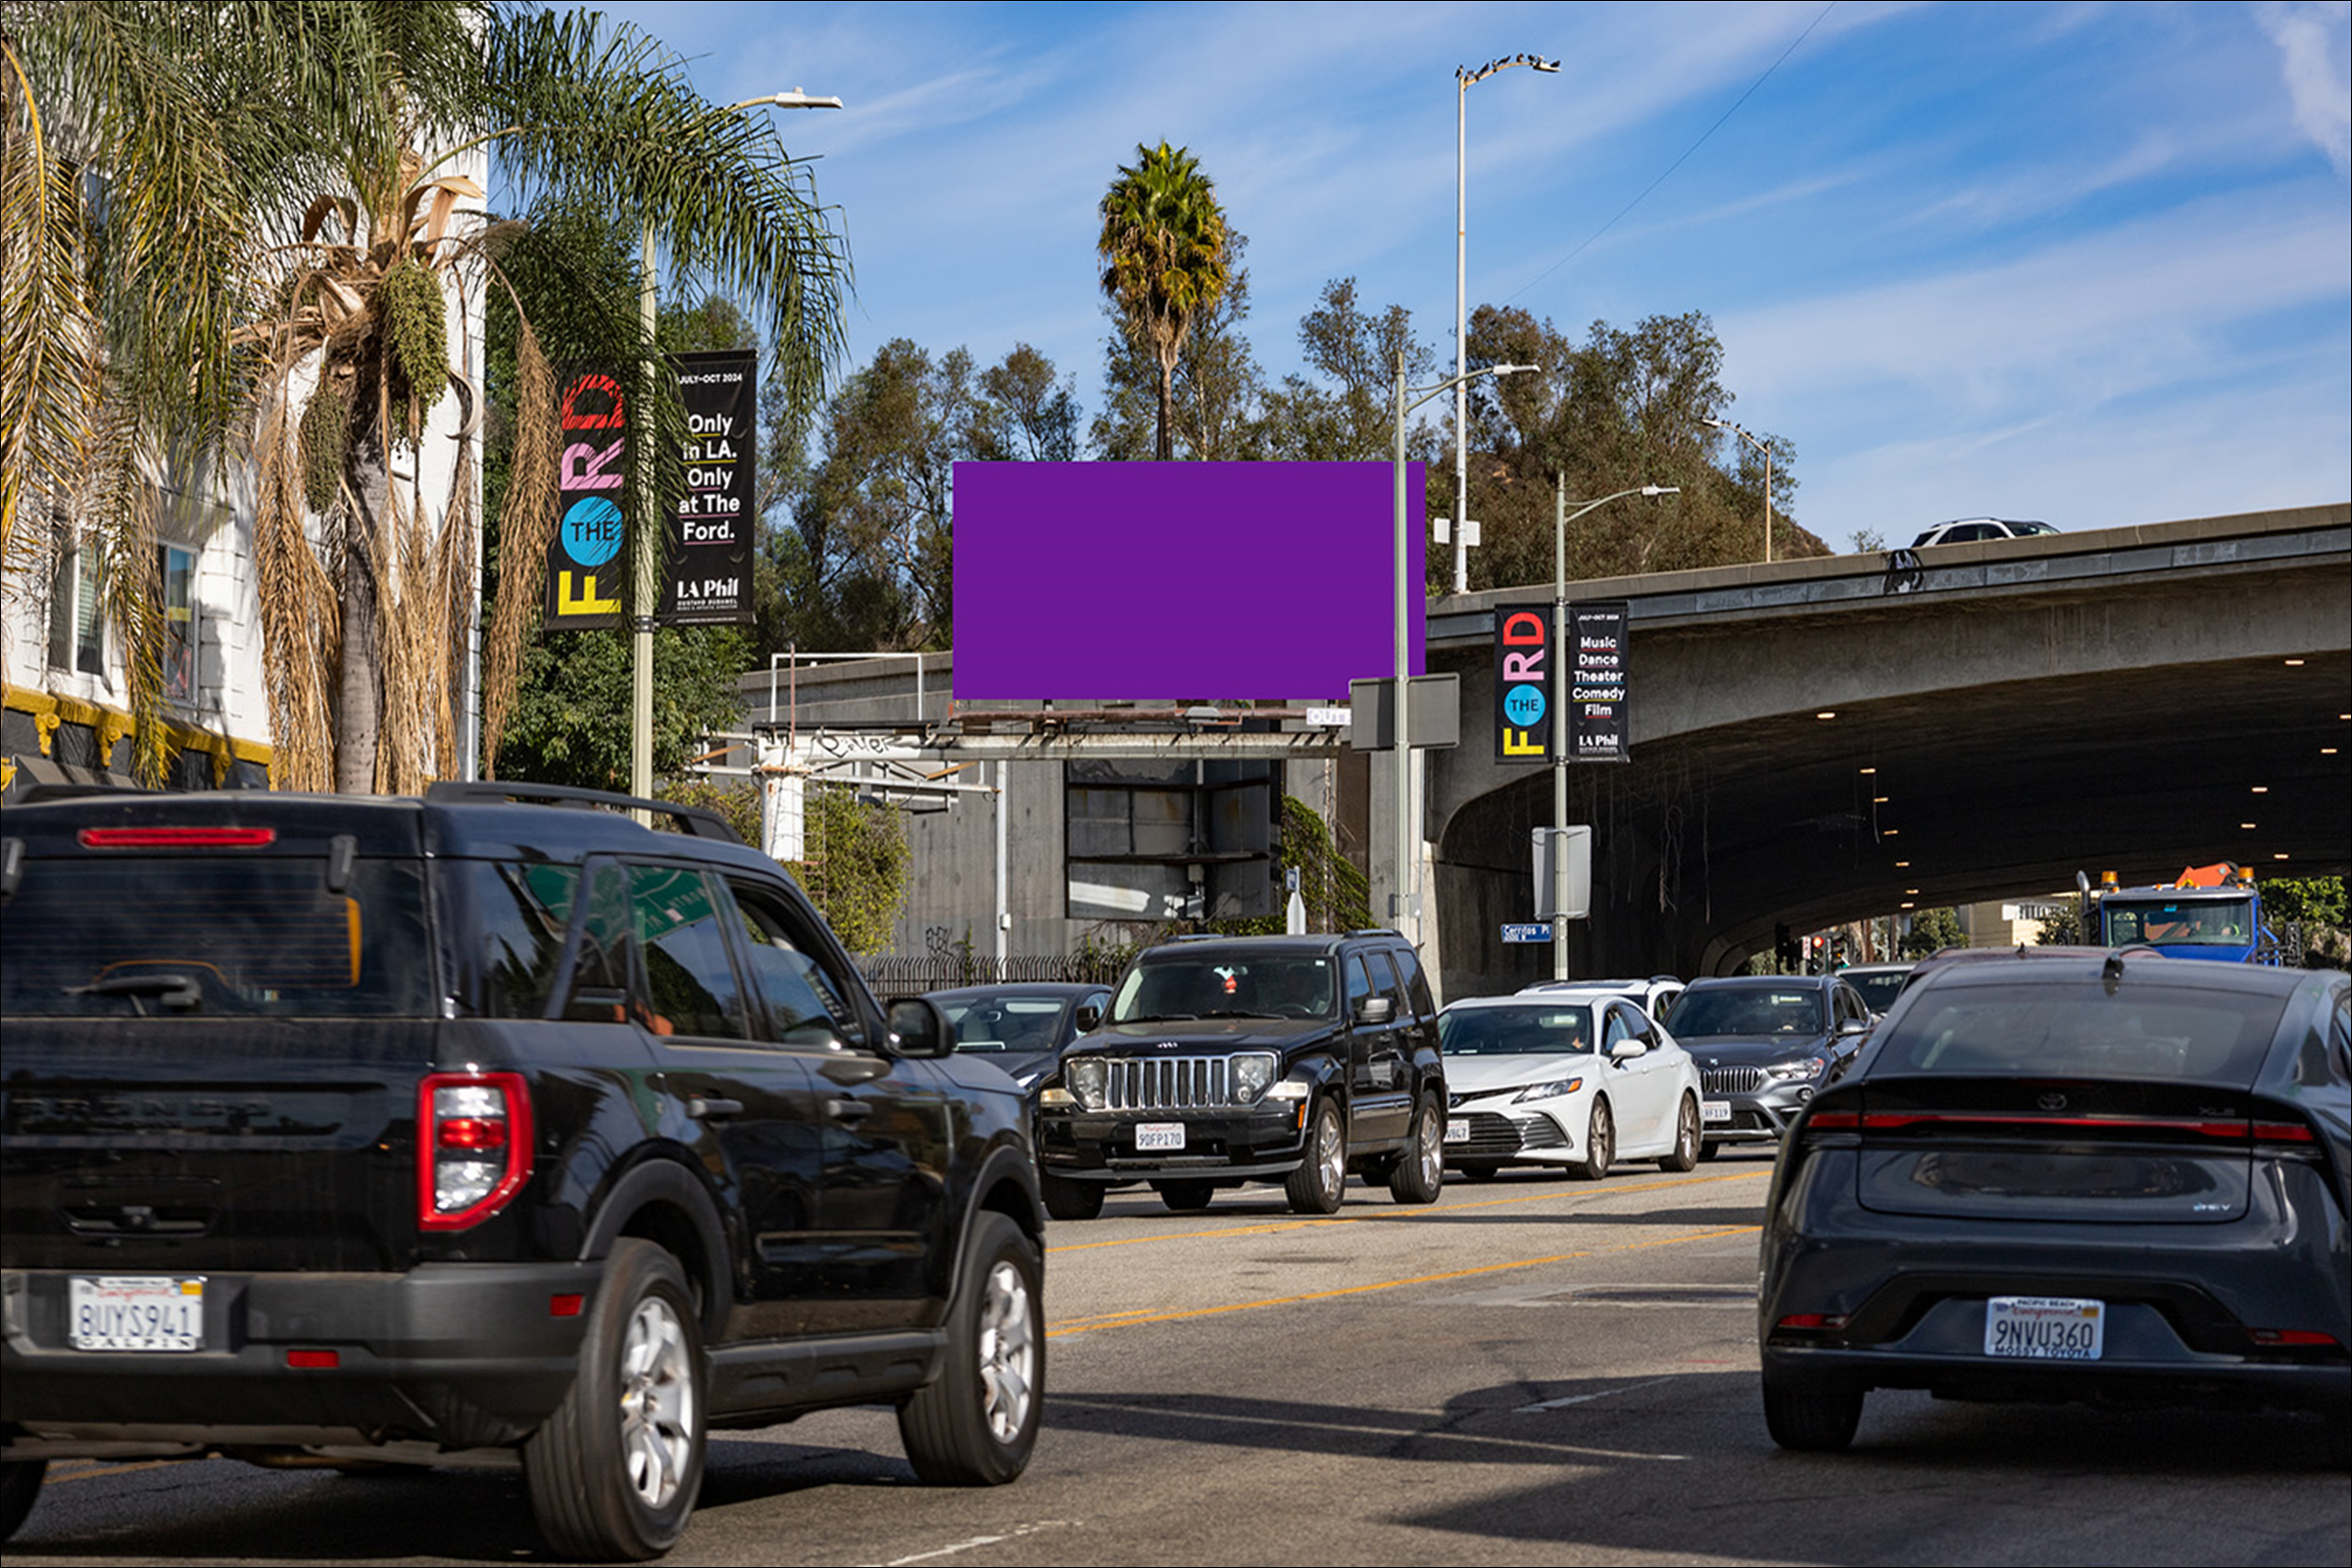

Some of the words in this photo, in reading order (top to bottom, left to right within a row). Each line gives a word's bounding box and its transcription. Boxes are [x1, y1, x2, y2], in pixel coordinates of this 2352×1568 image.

[721, 372, 743, 383] 2024
[688, 413, 733, 436] Only
[682, 441, 700, 461] in
[706, 439, 738, 459] LA.
[687, 466, 733, 490] Only
[678, 495, 699, 514] at
[703, 493, 741, 513] The
[570, 520, 615, 541] THE
[683, 519, 736, 540] Ford.
[677, 580, 700, 599] LA
[704, 576, 739, 598] Phil
[1580, 636, 1617, 649] Music
[1578, 653, 1619, 665] Dance
[1573, 670, 1624, 682] Theater
[1572, 686, 1626, 702] Comedy
[1510, 699, 1540, 711] THE
[1585, 704, 1612, 715] Film
[1579, 735, 1593, 746] LA
[1595, 733, 1618, 746] Phil
[78, 1303, 193, 1337] 8UYS941
[1994, 1319, 2094, 1348] 9NVU360
